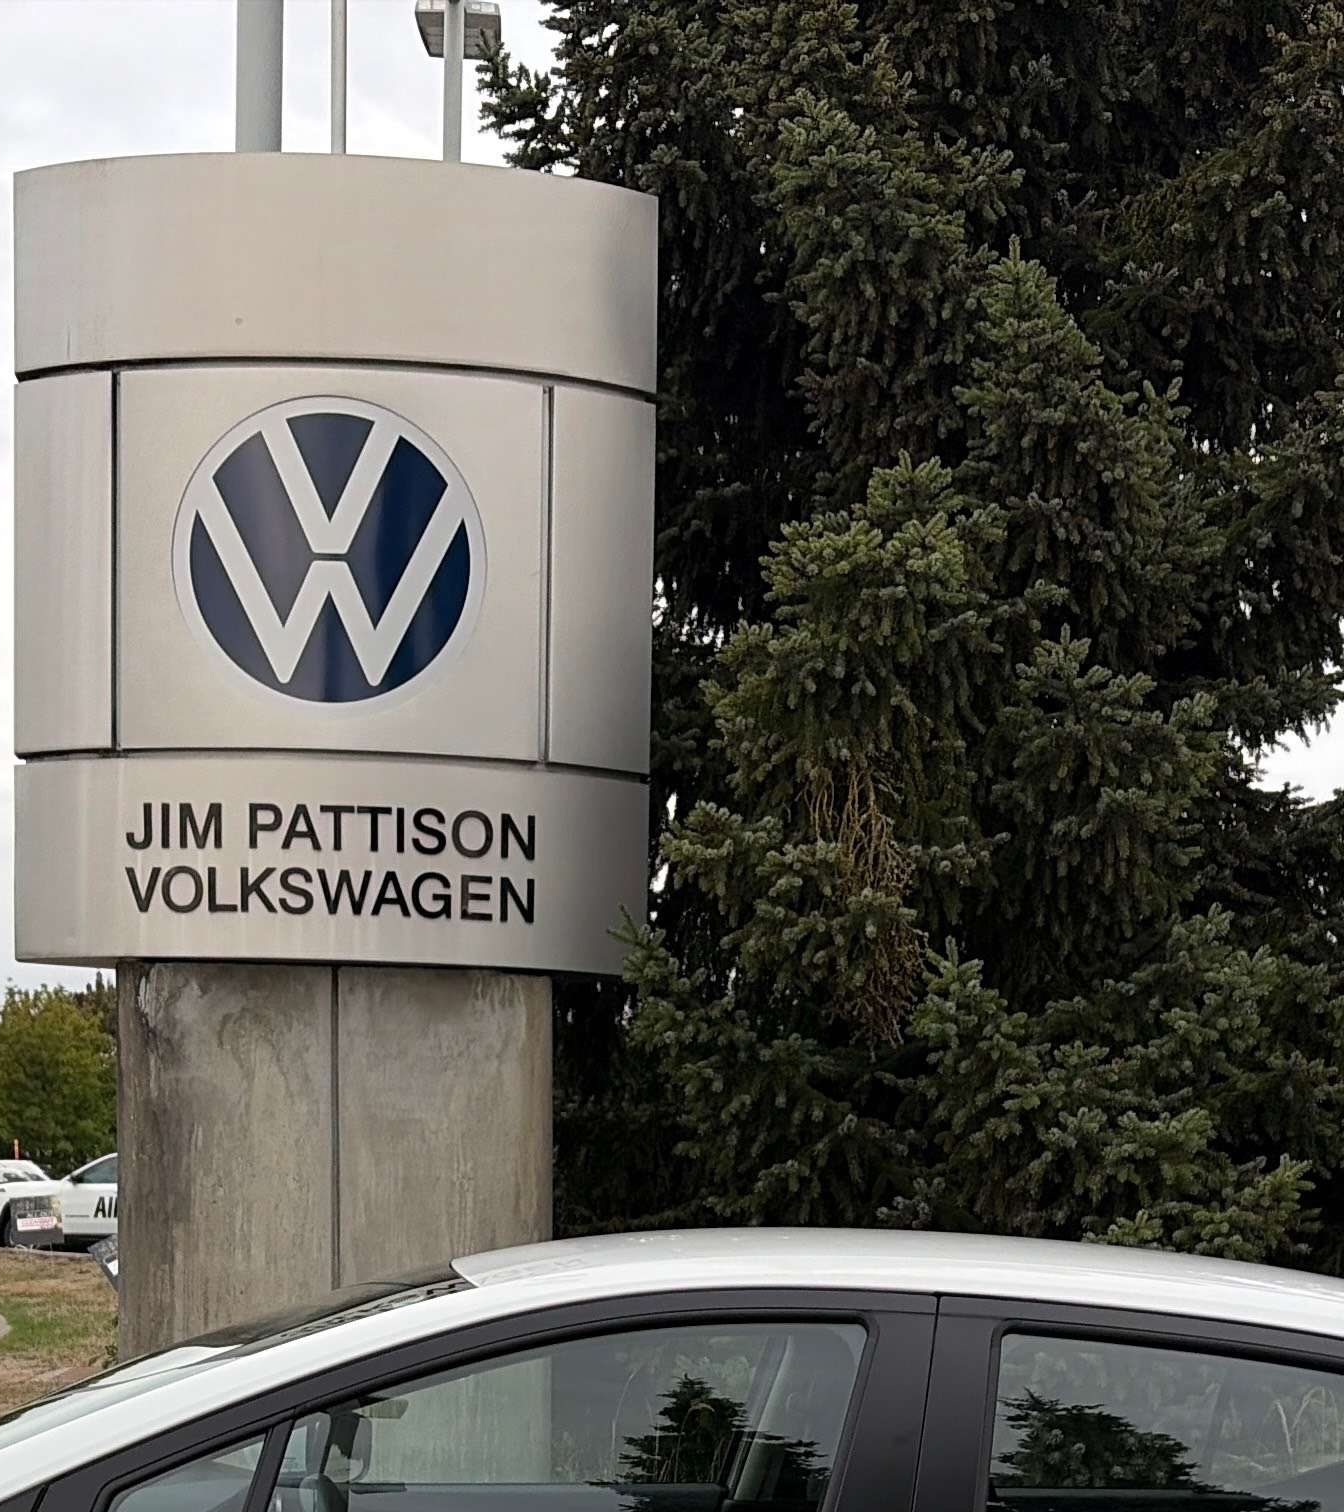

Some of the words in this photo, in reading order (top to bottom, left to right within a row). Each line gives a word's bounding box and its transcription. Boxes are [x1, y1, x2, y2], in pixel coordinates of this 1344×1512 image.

[186, 406, 474, 697] VW
[126, 802, 223, 851] JIM
[248, 802, 536, 861] PATTISON
[124, 865, 536, 924] VOLKSWAGEN
